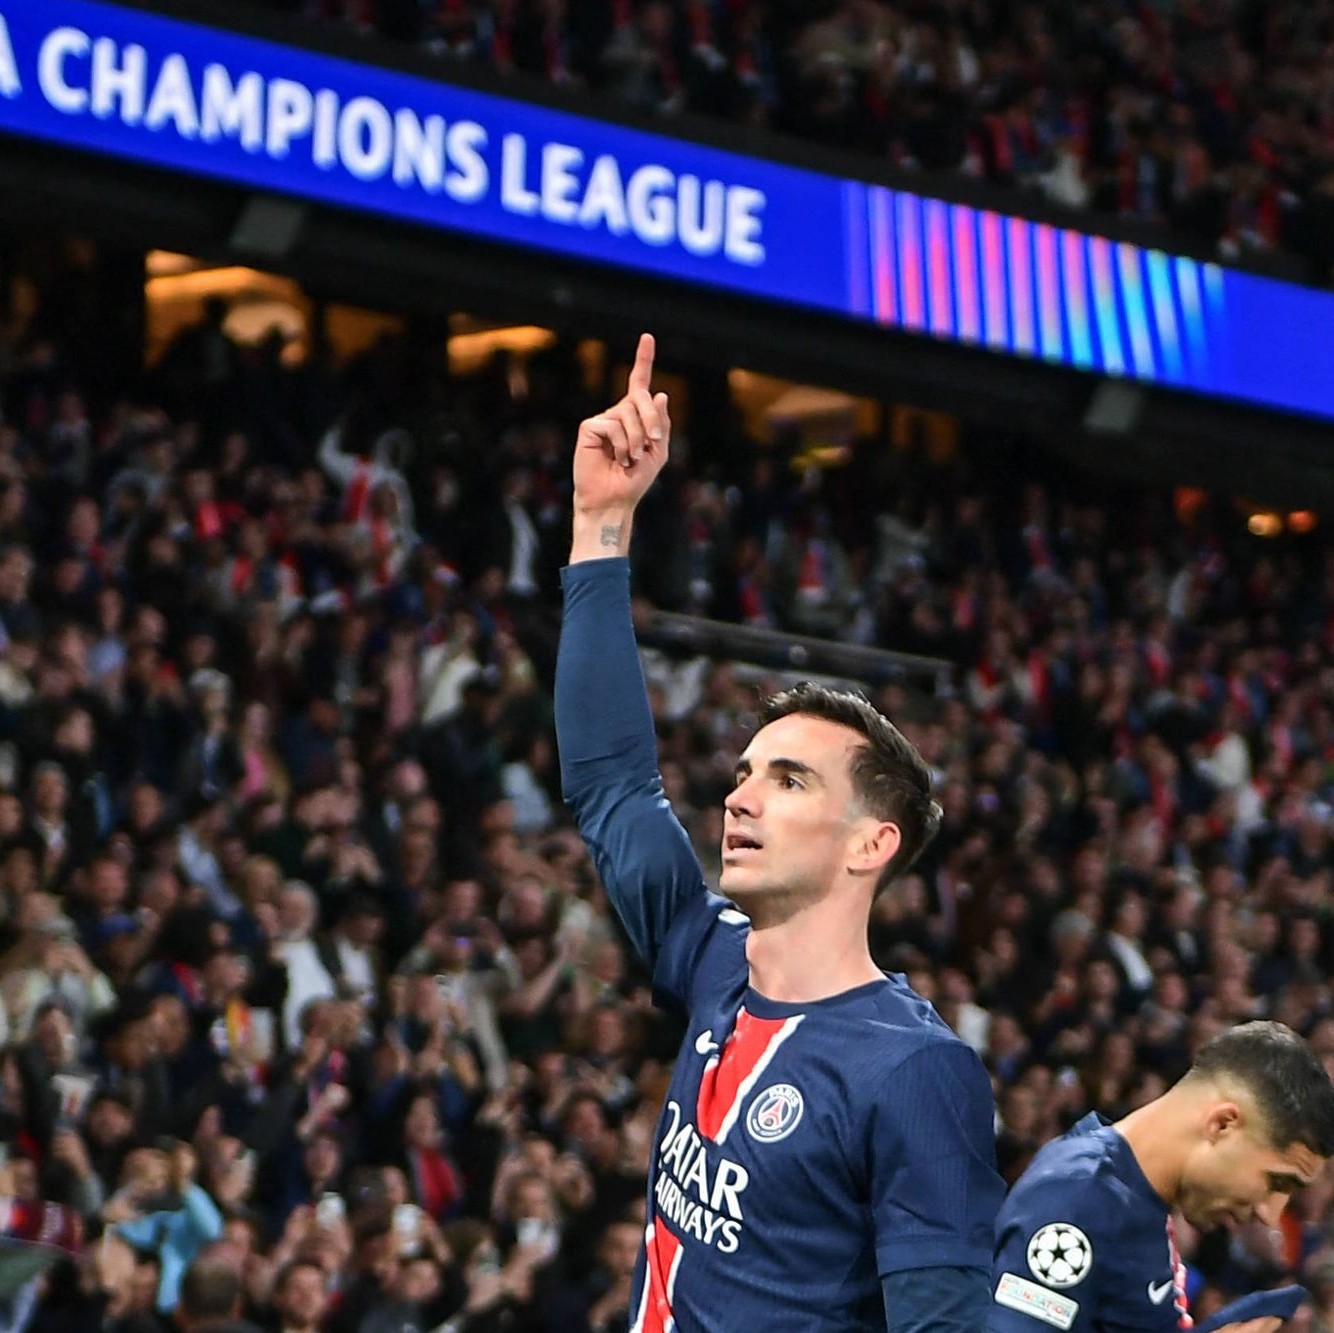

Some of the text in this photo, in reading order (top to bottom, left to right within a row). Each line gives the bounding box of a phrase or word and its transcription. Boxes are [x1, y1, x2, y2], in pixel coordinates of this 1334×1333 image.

[38, 27, 489, 203] CHAMPIONS
[500, 133, 766, 267] LEAGUE
[655, 1171, 742, 1253] AIRWAYS
